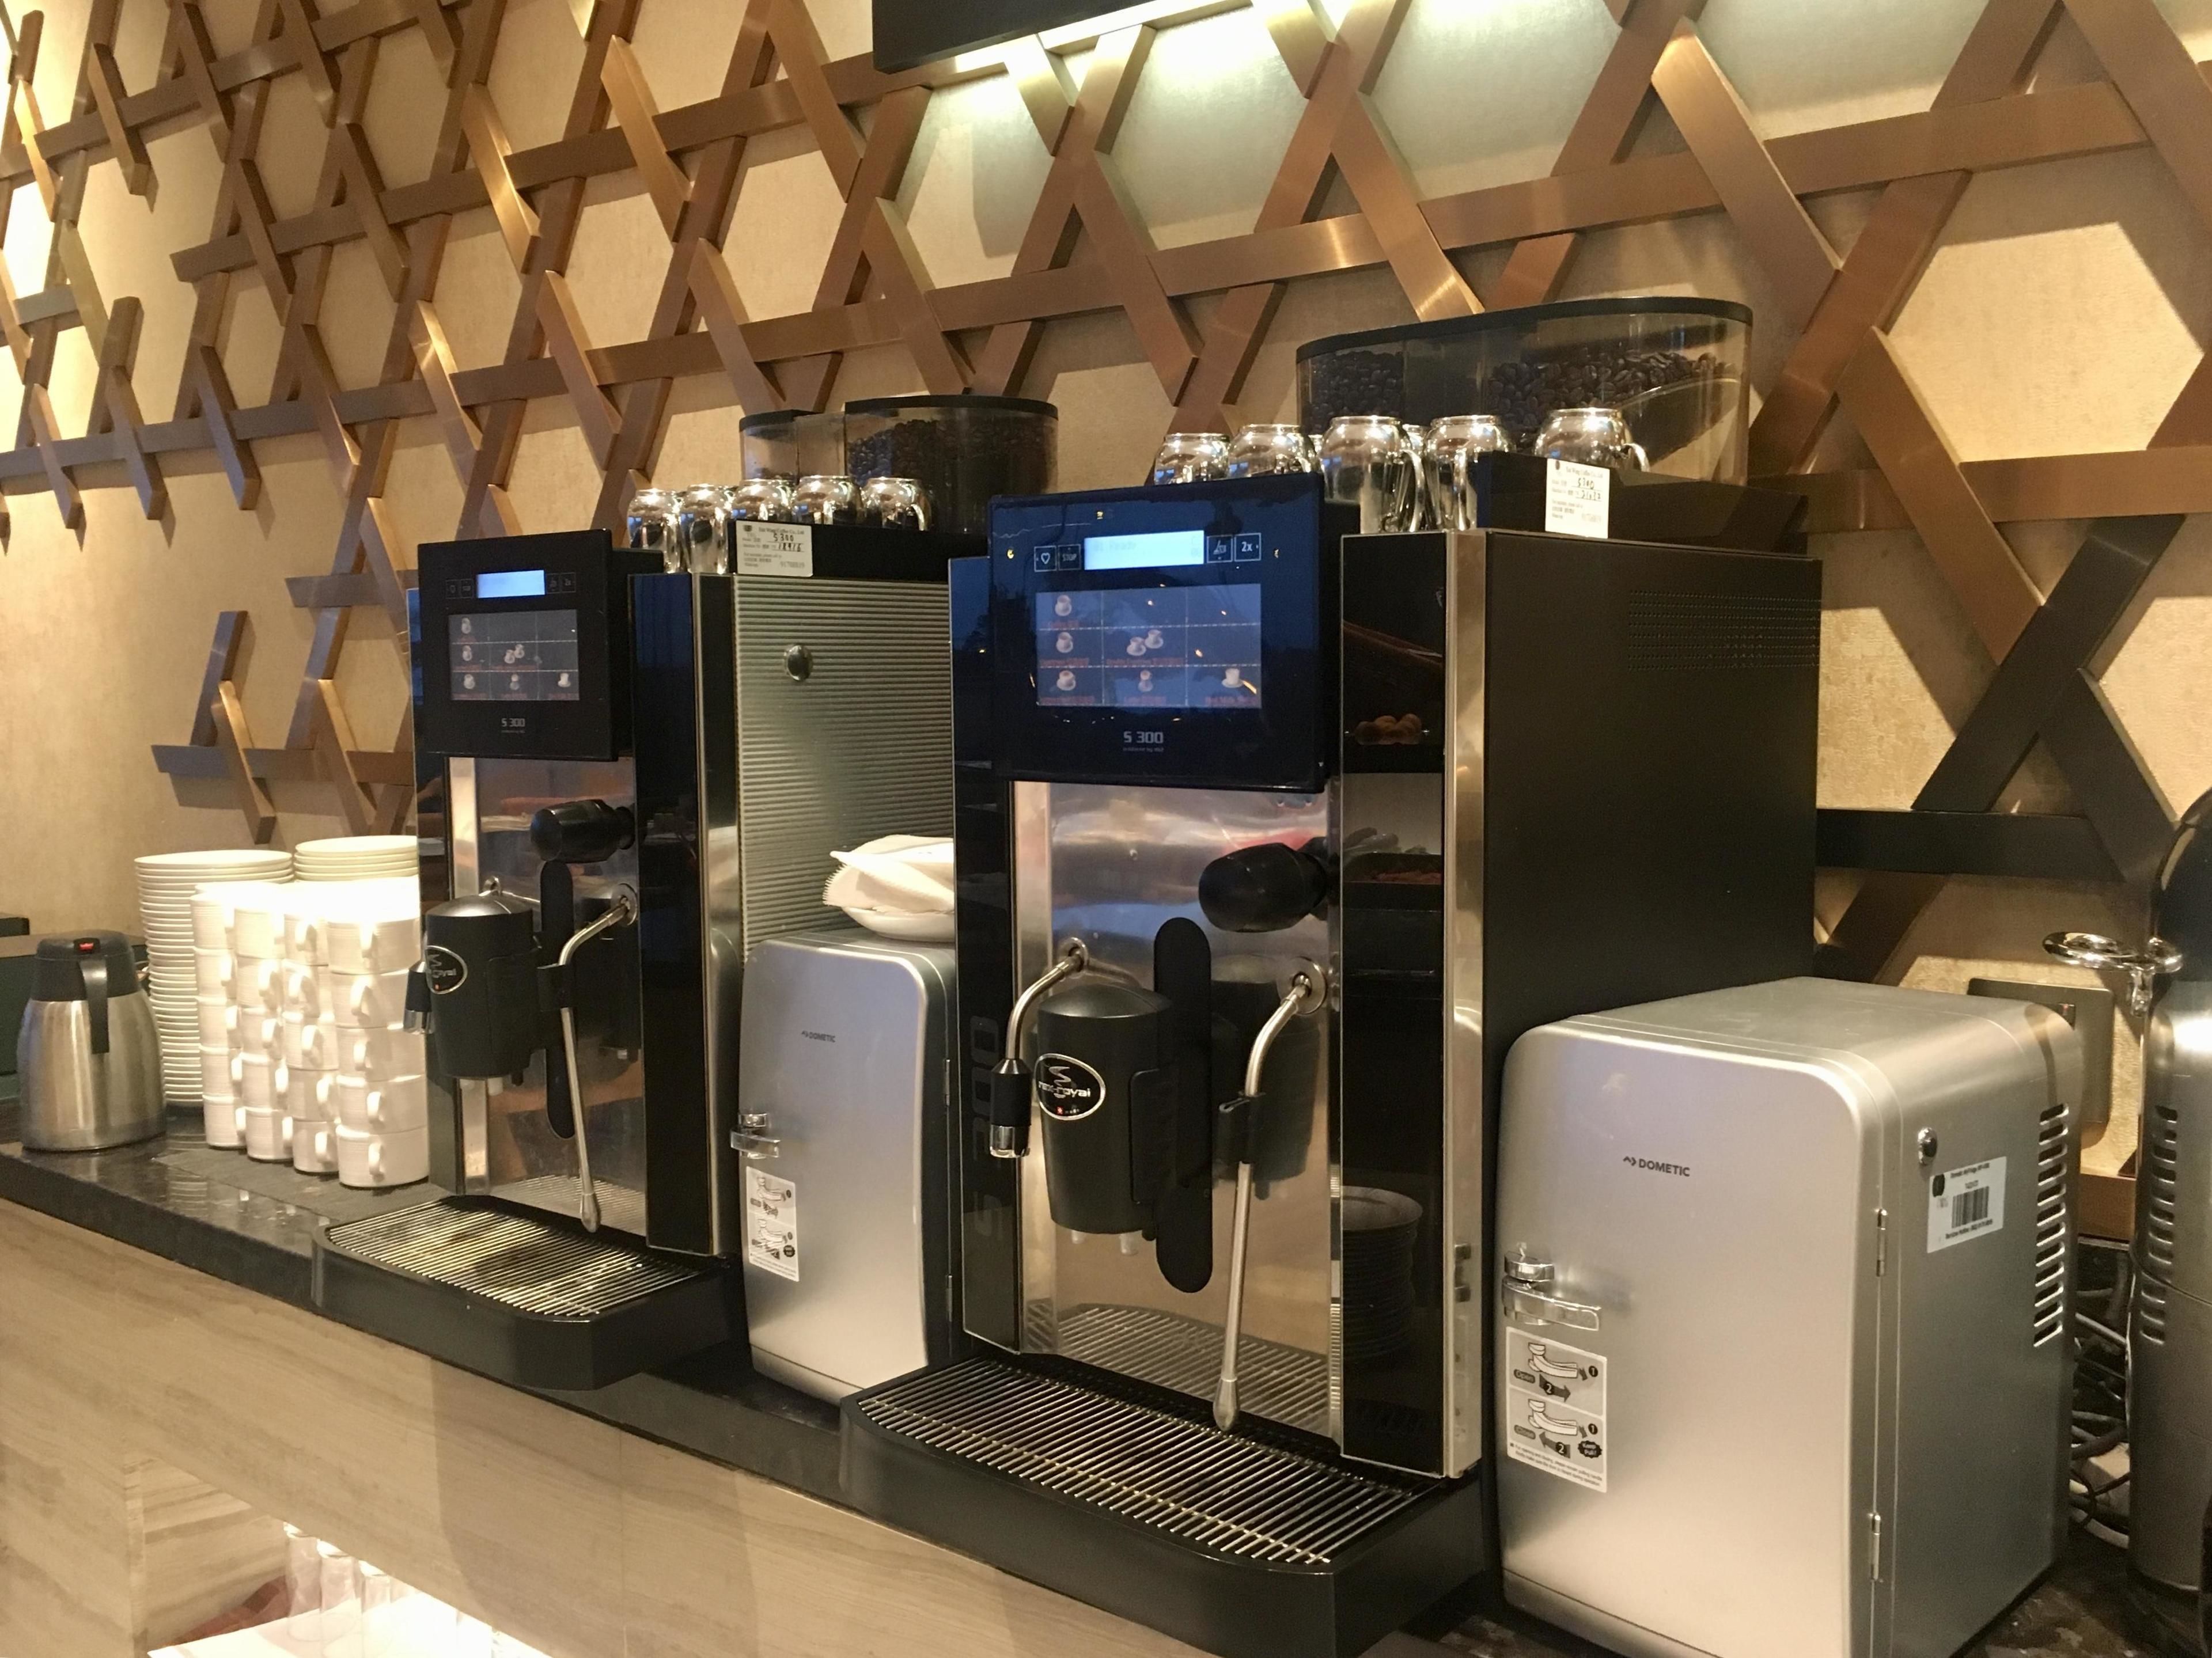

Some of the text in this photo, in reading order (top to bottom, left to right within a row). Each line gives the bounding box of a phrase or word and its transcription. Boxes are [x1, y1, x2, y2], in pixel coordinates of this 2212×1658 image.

[1241, 541, 1253, 552] 2x
[501, 718, 526, 727] S 300
[1123, 731, 1164, 743] S 300
[809, 1031, 836, 1043] DOMETIC
[1638, 1158, 1691, 1177] DOMETIC
